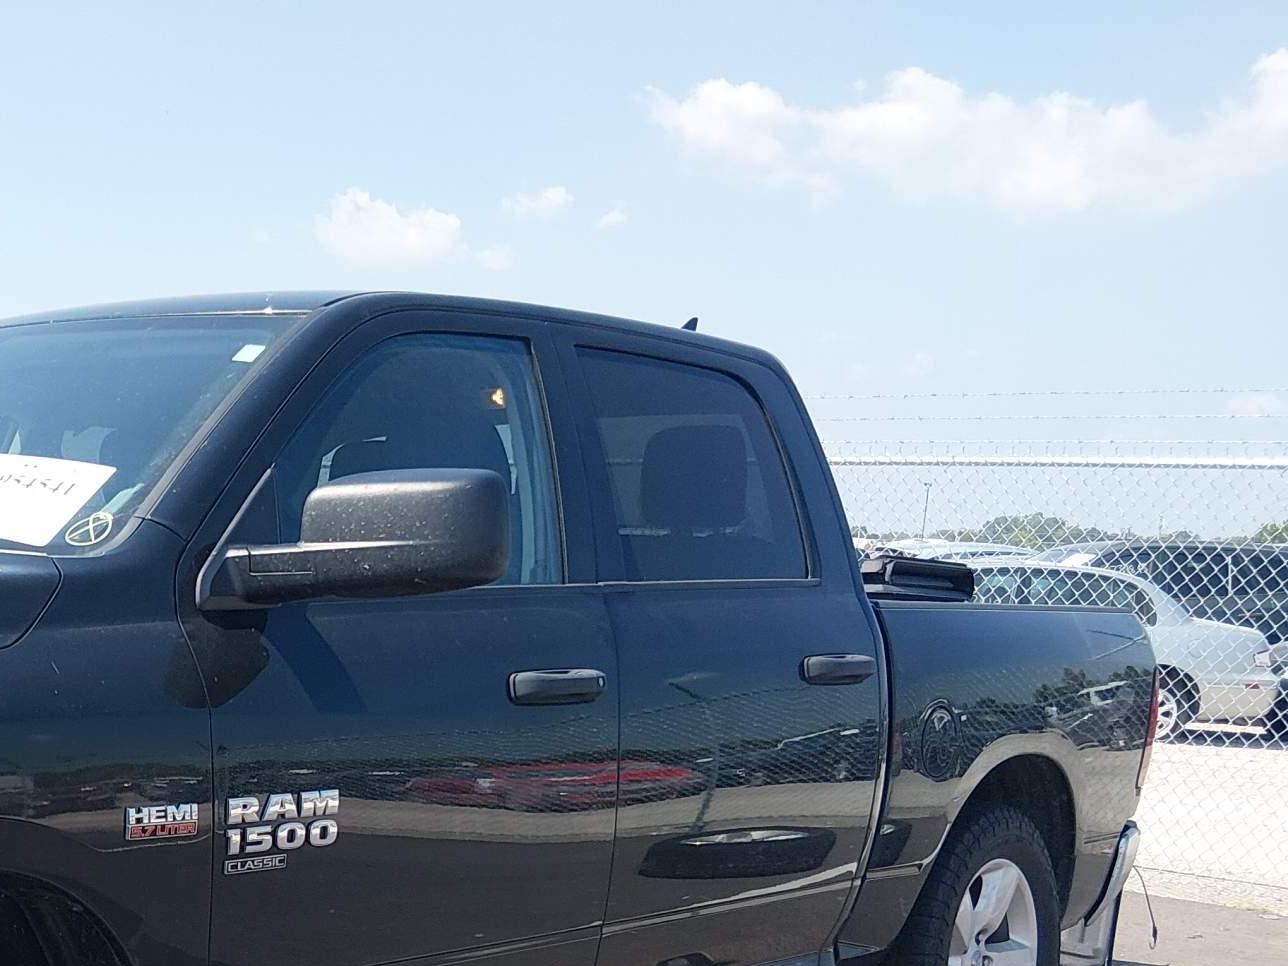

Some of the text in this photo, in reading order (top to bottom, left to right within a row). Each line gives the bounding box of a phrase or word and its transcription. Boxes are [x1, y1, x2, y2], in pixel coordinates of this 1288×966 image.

[126, 803, 199, 825] HEMI
[227, 788, 340, 825] RAM
[130, 822, 196, 838] 5.7 LITER
[226, 819, 338, 855] 1500
[227, 855, 285, 873] CLASSIC
